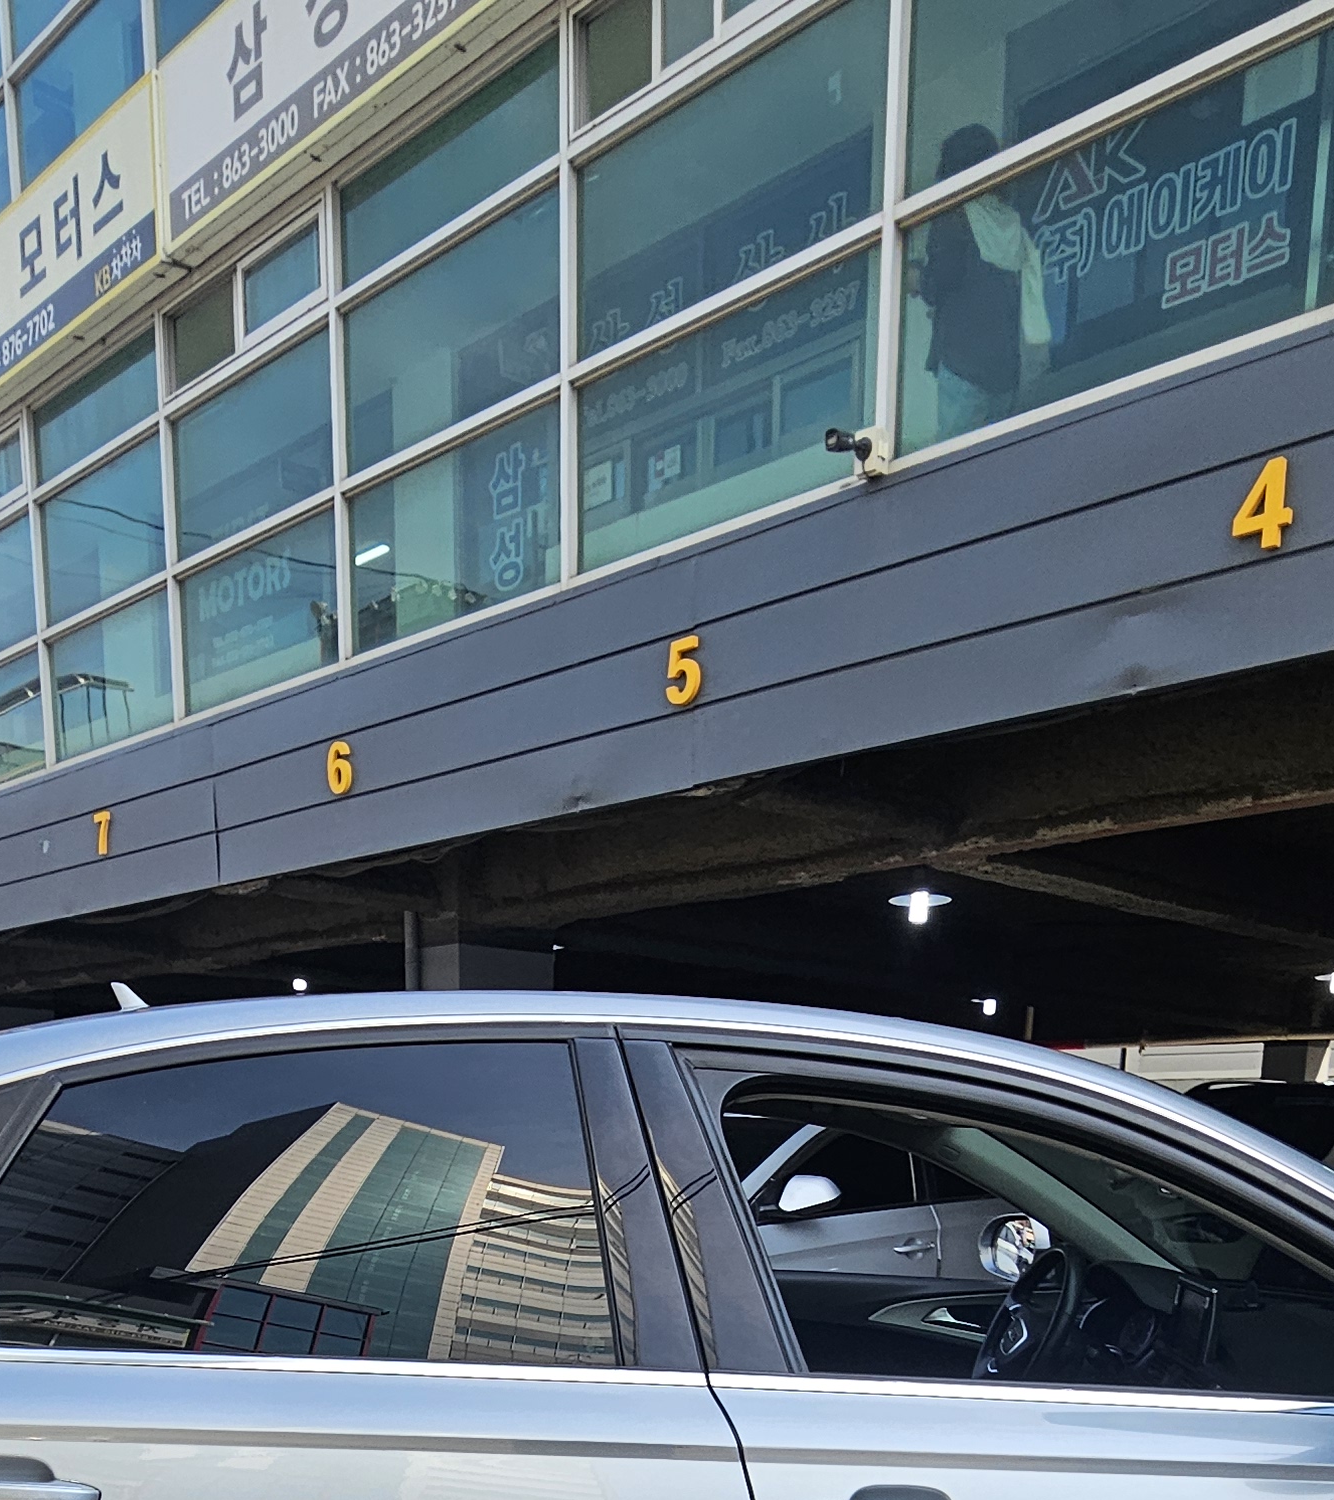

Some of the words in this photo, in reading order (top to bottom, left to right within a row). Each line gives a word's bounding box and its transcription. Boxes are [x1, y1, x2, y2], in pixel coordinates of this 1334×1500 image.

[19, 150, 125, 299] 모터스
[1161, 211, 1291, 309] 모터스
[489, 441, 526, 593] 삼성
[1231, 455, 1294, 550] 4
[665, 635, 701, 706] 5
[327, 741, 353, 794] 6
[94, 810, 111, 856] 7
